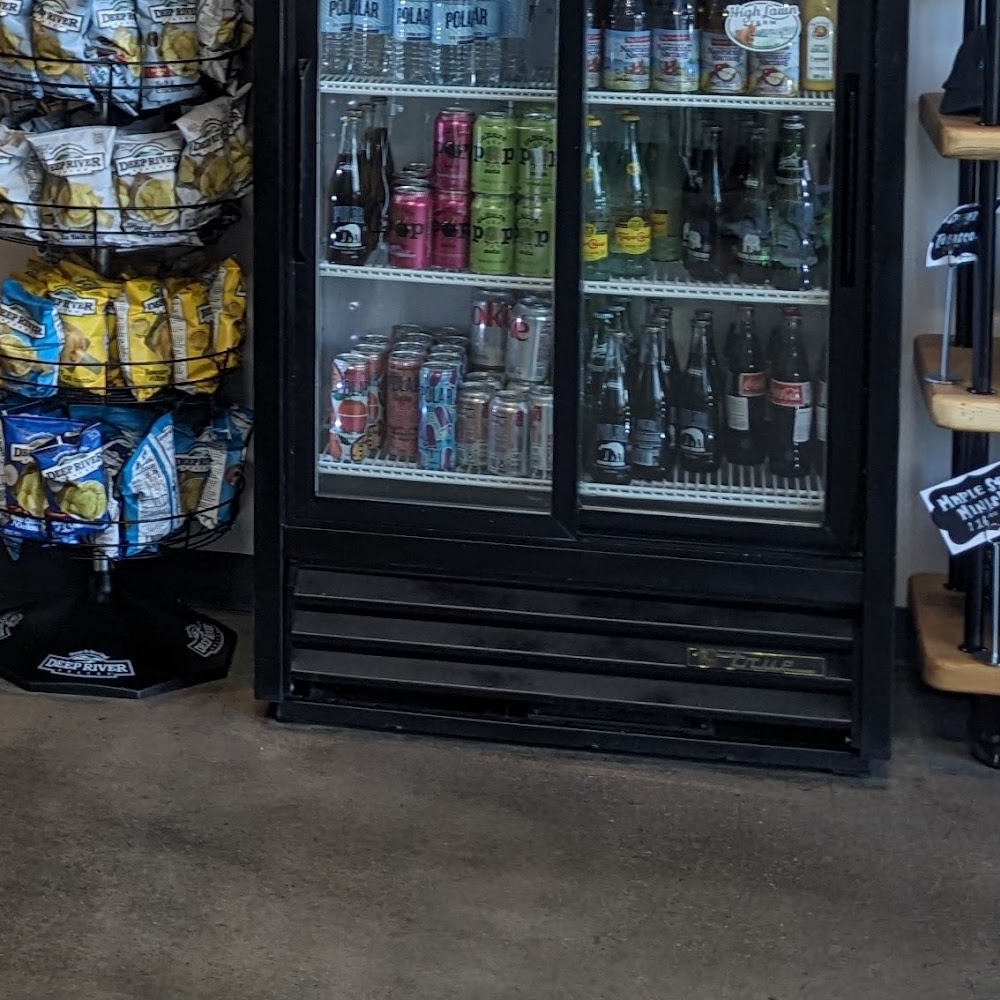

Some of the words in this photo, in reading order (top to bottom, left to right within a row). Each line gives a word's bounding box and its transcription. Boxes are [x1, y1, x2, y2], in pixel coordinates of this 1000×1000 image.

[101, 12, 124, 24] DEEP
[730, 5, 760, 18] High
[763, 4, 798, 19] Lawn
[47, 11, 80, 28] RIVER
[68, 156, 102, 170] RIVER
[118, 159, 147, 171] DEEP
[47, 465, 73, 480] DEEP
[936, 484, 987, 512] MAPLE
[47, 658, 82, 671] DEEP
[82, 660, 128, 673] RIVER
